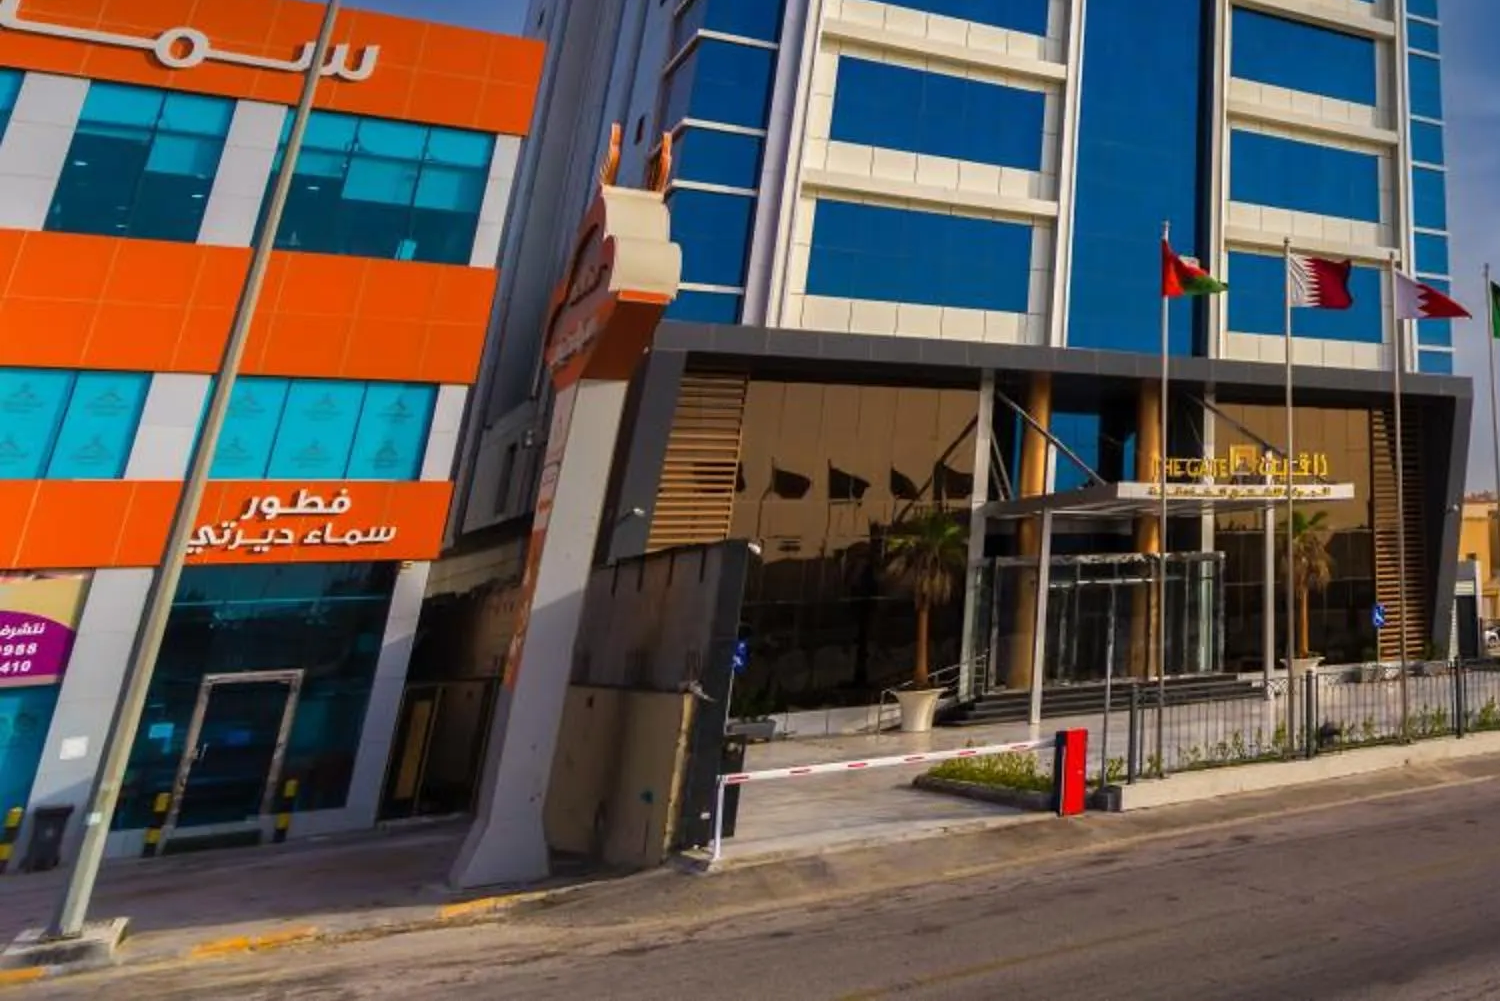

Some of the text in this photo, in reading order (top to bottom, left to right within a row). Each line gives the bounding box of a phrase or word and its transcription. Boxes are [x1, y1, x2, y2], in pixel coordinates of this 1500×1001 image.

[1186, 457, 1229, 479] GATE
[240, 487, 353, 521] فطور
[182, 519, 397, 555] سماء ديرتي
